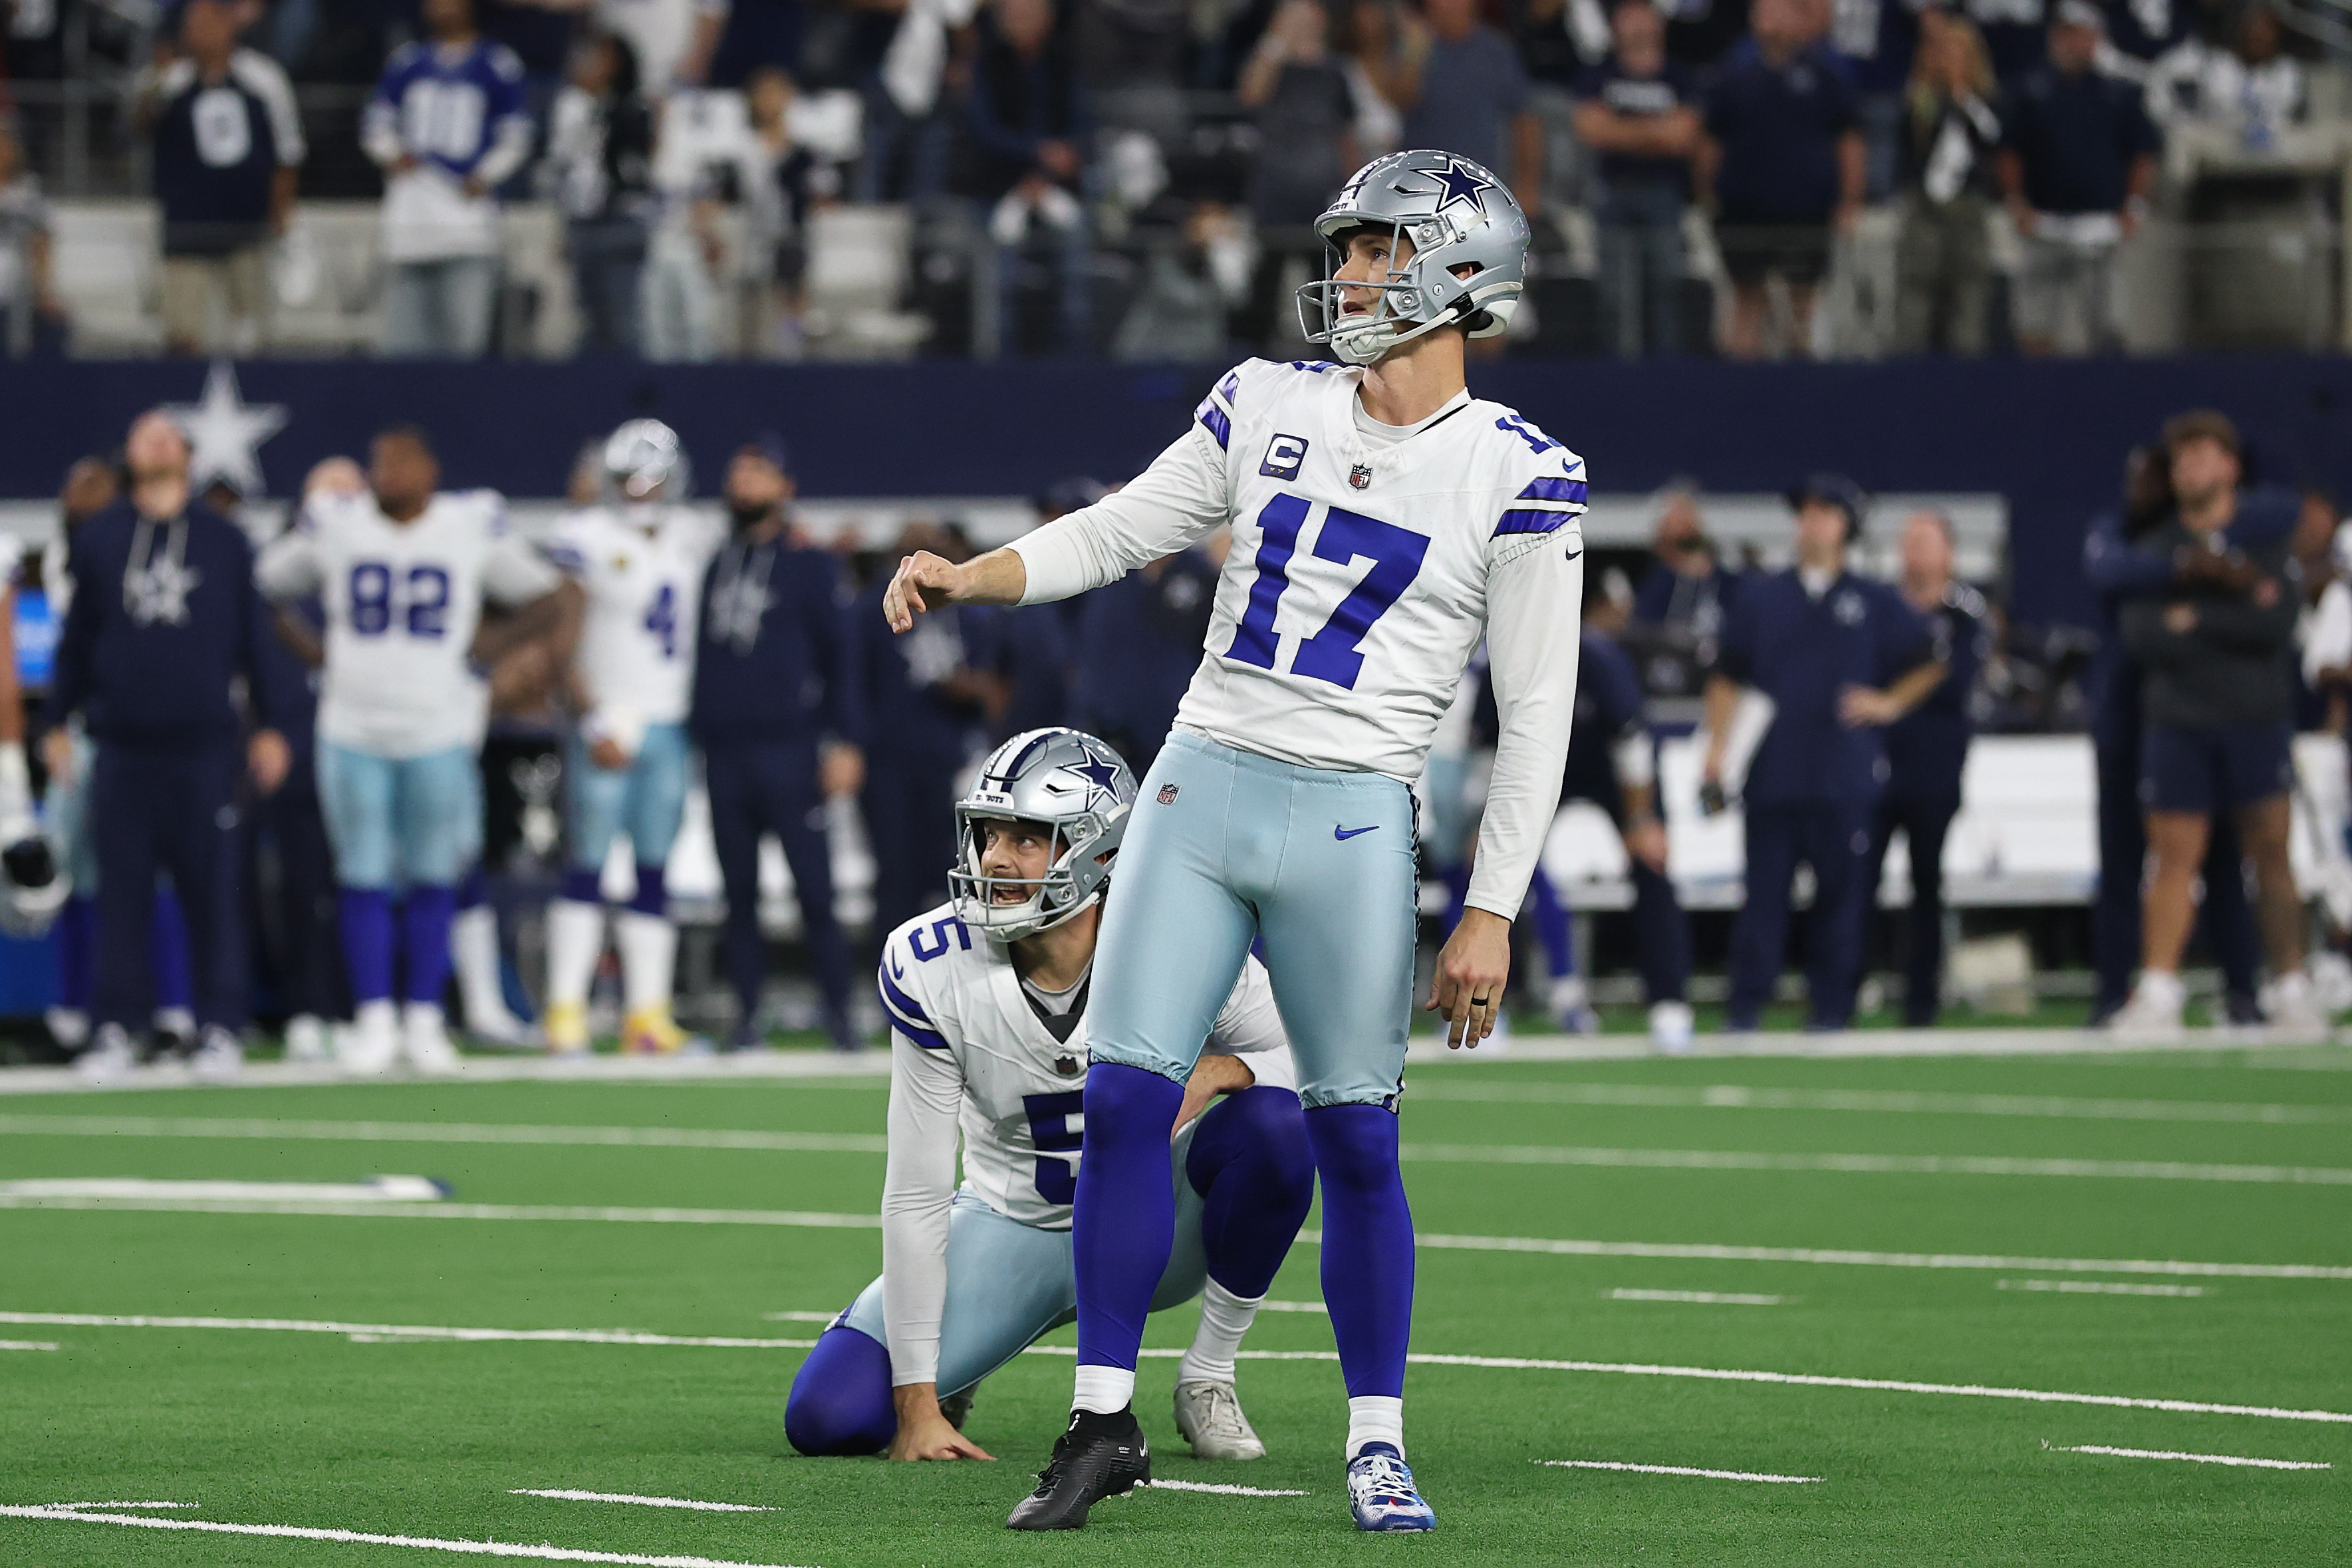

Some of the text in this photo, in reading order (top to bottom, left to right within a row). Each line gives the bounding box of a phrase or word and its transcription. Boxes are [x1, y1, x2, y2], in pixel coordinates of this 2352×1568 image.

[1266, 436, 1303, 469] C
[349, 561, 449, 636] 82
[644, 583, 677, 658] 4
[1222, 492, 1432, 692] 17
[908, 915, 972, 963] 5
[1021, 1089, 1085, 1205] 5
